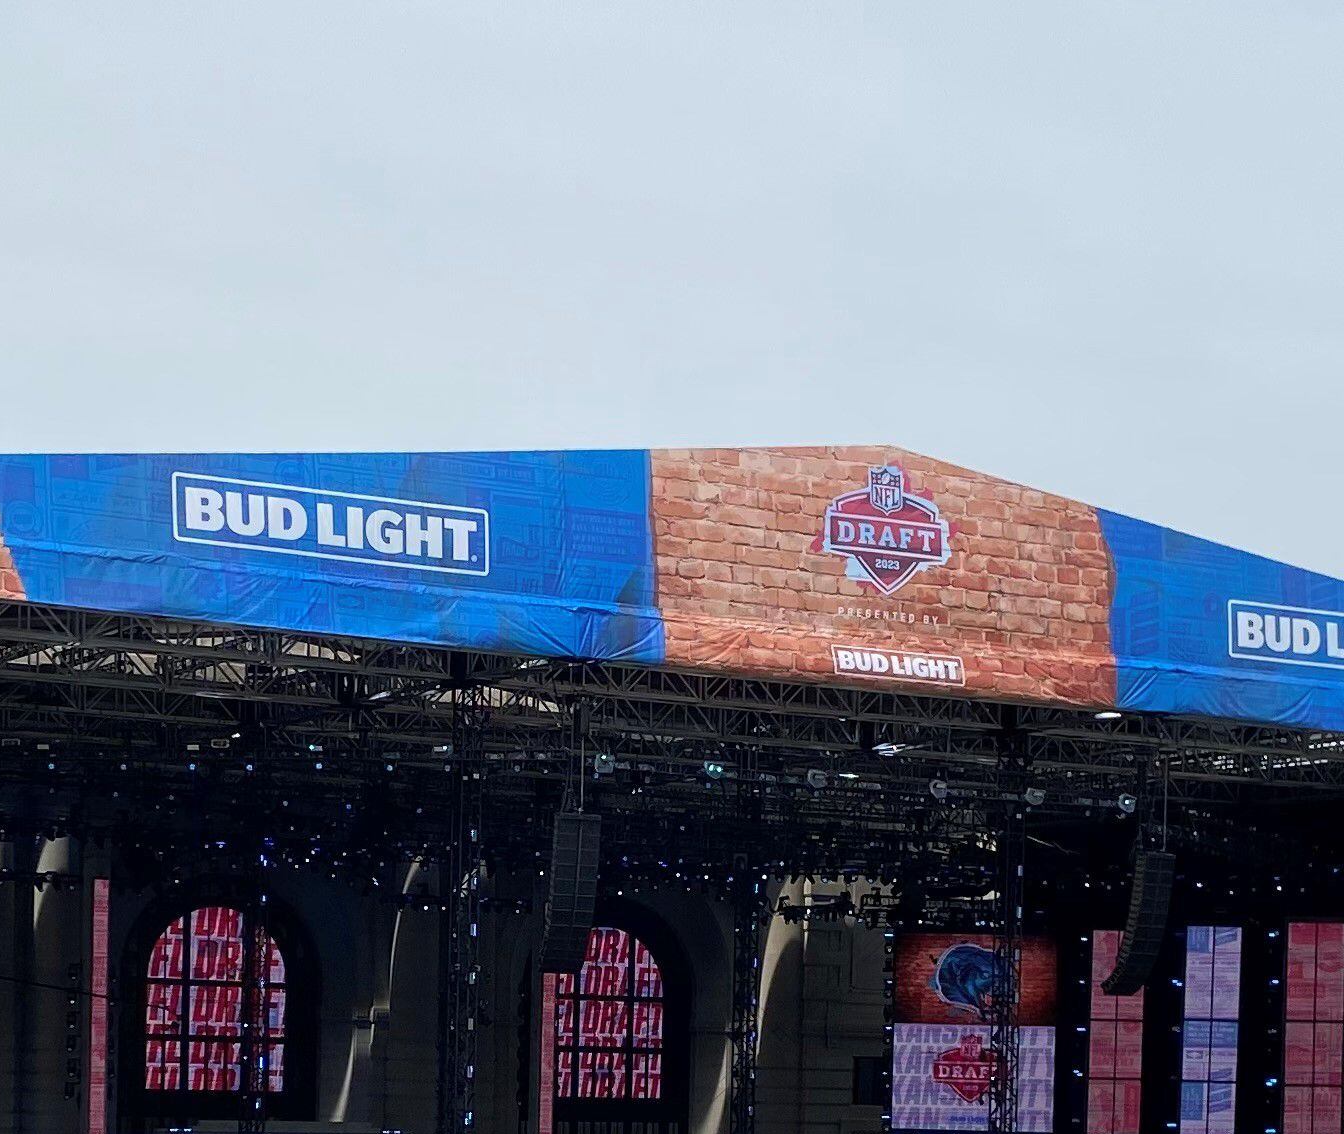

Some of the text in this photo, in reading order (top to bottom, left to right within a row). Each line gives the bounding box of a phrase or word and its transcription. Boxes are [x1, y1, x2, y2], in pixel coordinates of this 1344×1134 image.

[874, 487, 900, 508] NFL
[184, 486, 478, 562] BUD LIGHT
[837, 520, 935, 552] DRAFT
[875, 558, 900, 571] 2023
[837, 607, 939, 625] PRESENTED BY
[1237, 611, 1321, 655] BUD
[837, 650, 959, 680] BUD LIGHT
